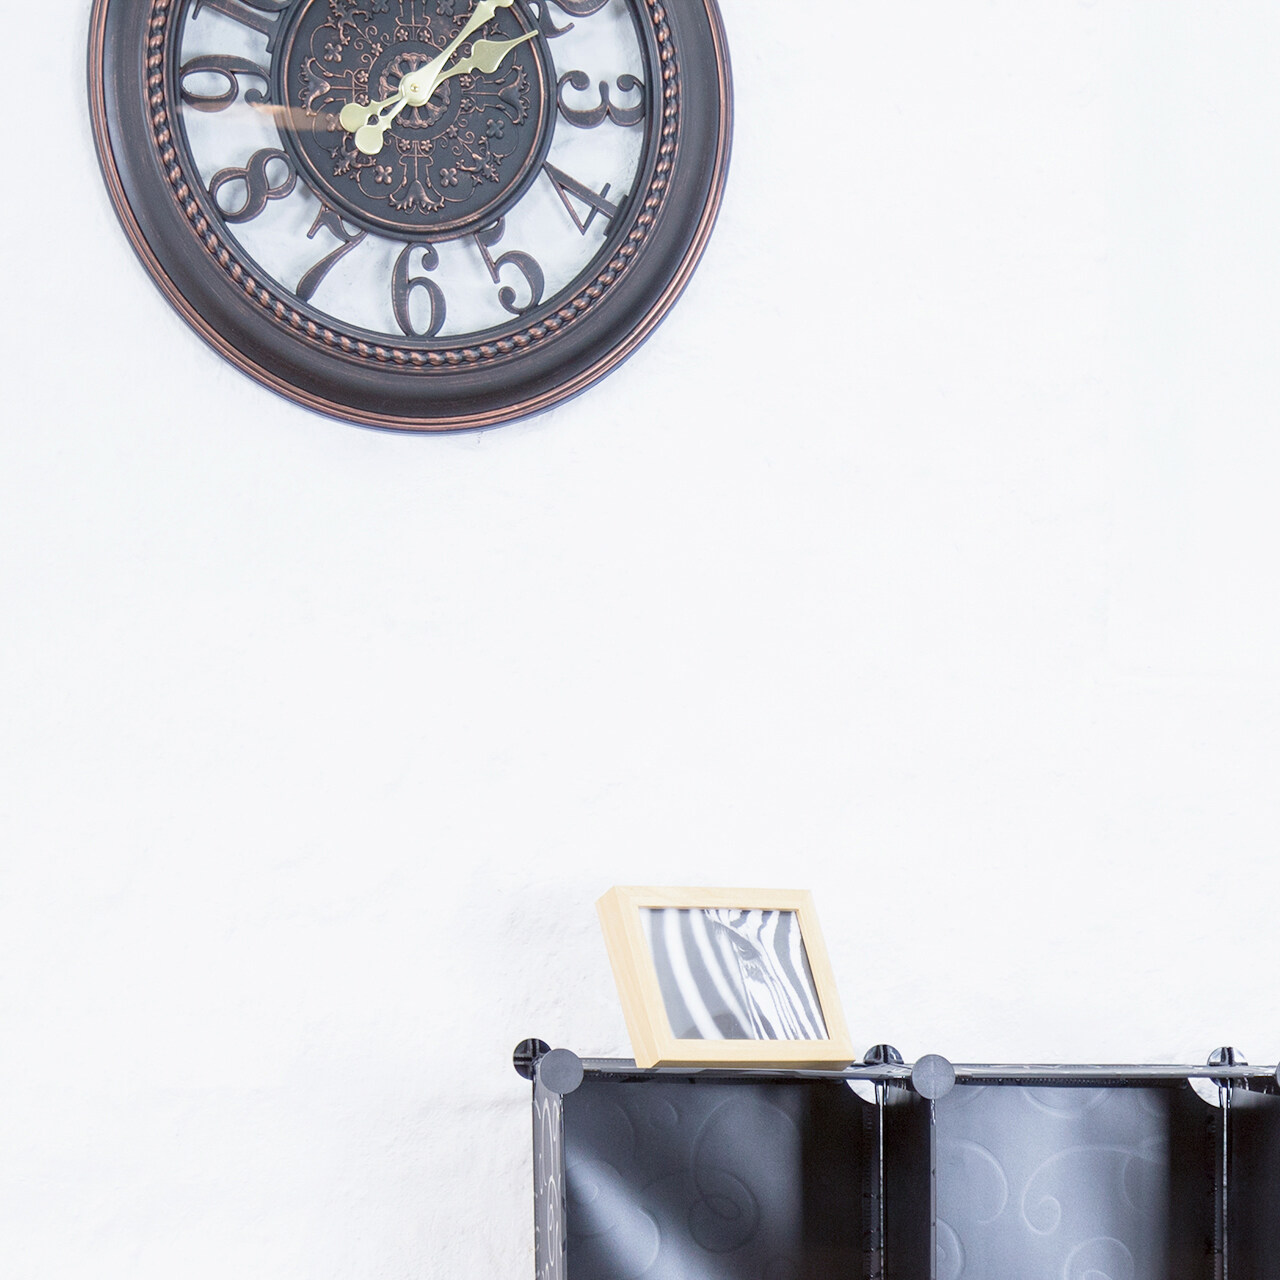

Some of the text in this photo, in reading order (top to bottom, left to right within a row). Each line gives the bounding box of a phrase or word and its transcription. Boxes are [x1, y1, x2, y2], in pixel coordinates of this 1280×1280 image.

[179, 54, 270, 113] 9
[556, 70, 646, 130] 3
[207, 147, 297, 224] 8
[545, 160, 629, 237] 4
[296, 205, 366, 302] 7
[391, 241, 447, 337] 6
[473, 221, 545, 316] 5
